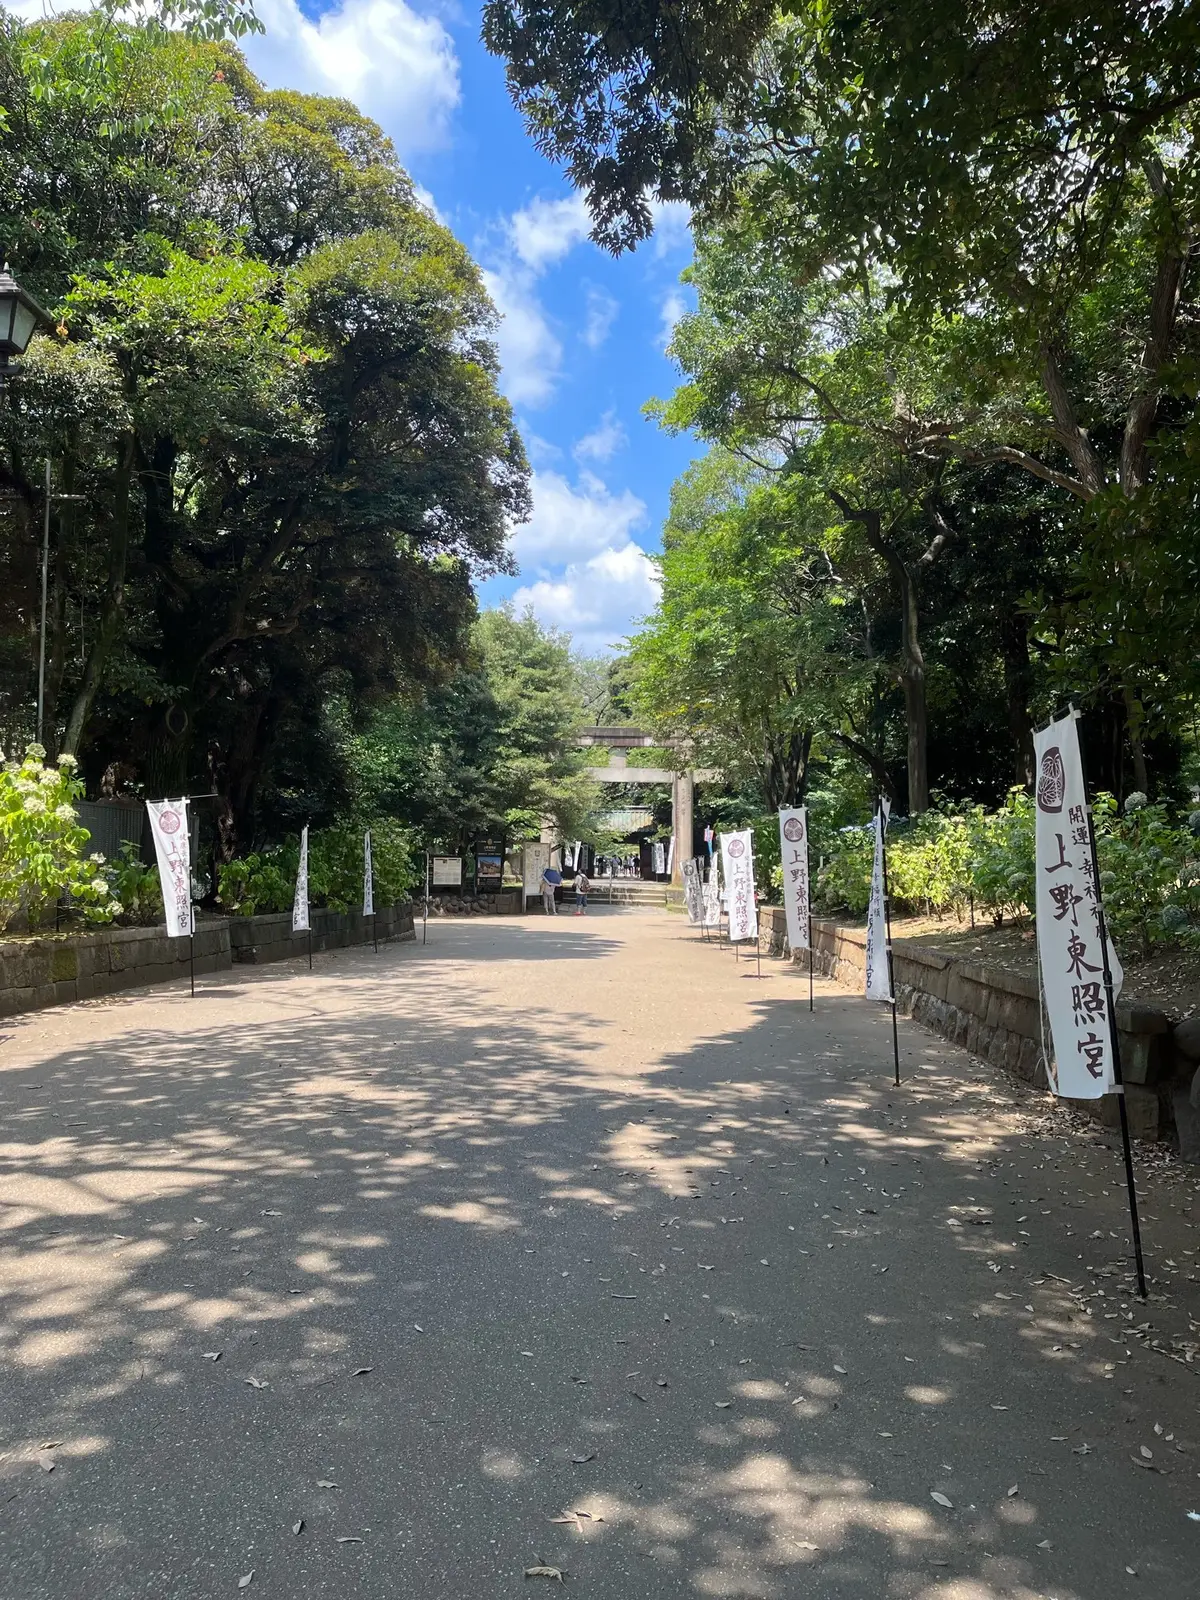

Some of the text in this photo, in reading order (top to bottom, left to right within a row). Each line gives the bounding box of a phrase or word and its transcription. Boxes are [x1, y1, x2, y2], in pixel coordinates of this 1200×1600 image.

[167, 841, 189, 928] 上野東照宮
[733, 863, 749, 933] 上野東照宮
[789, 850, 808, 940] 上野東照宮
[1044, 833, 1105, 1079] 上野東照宮
